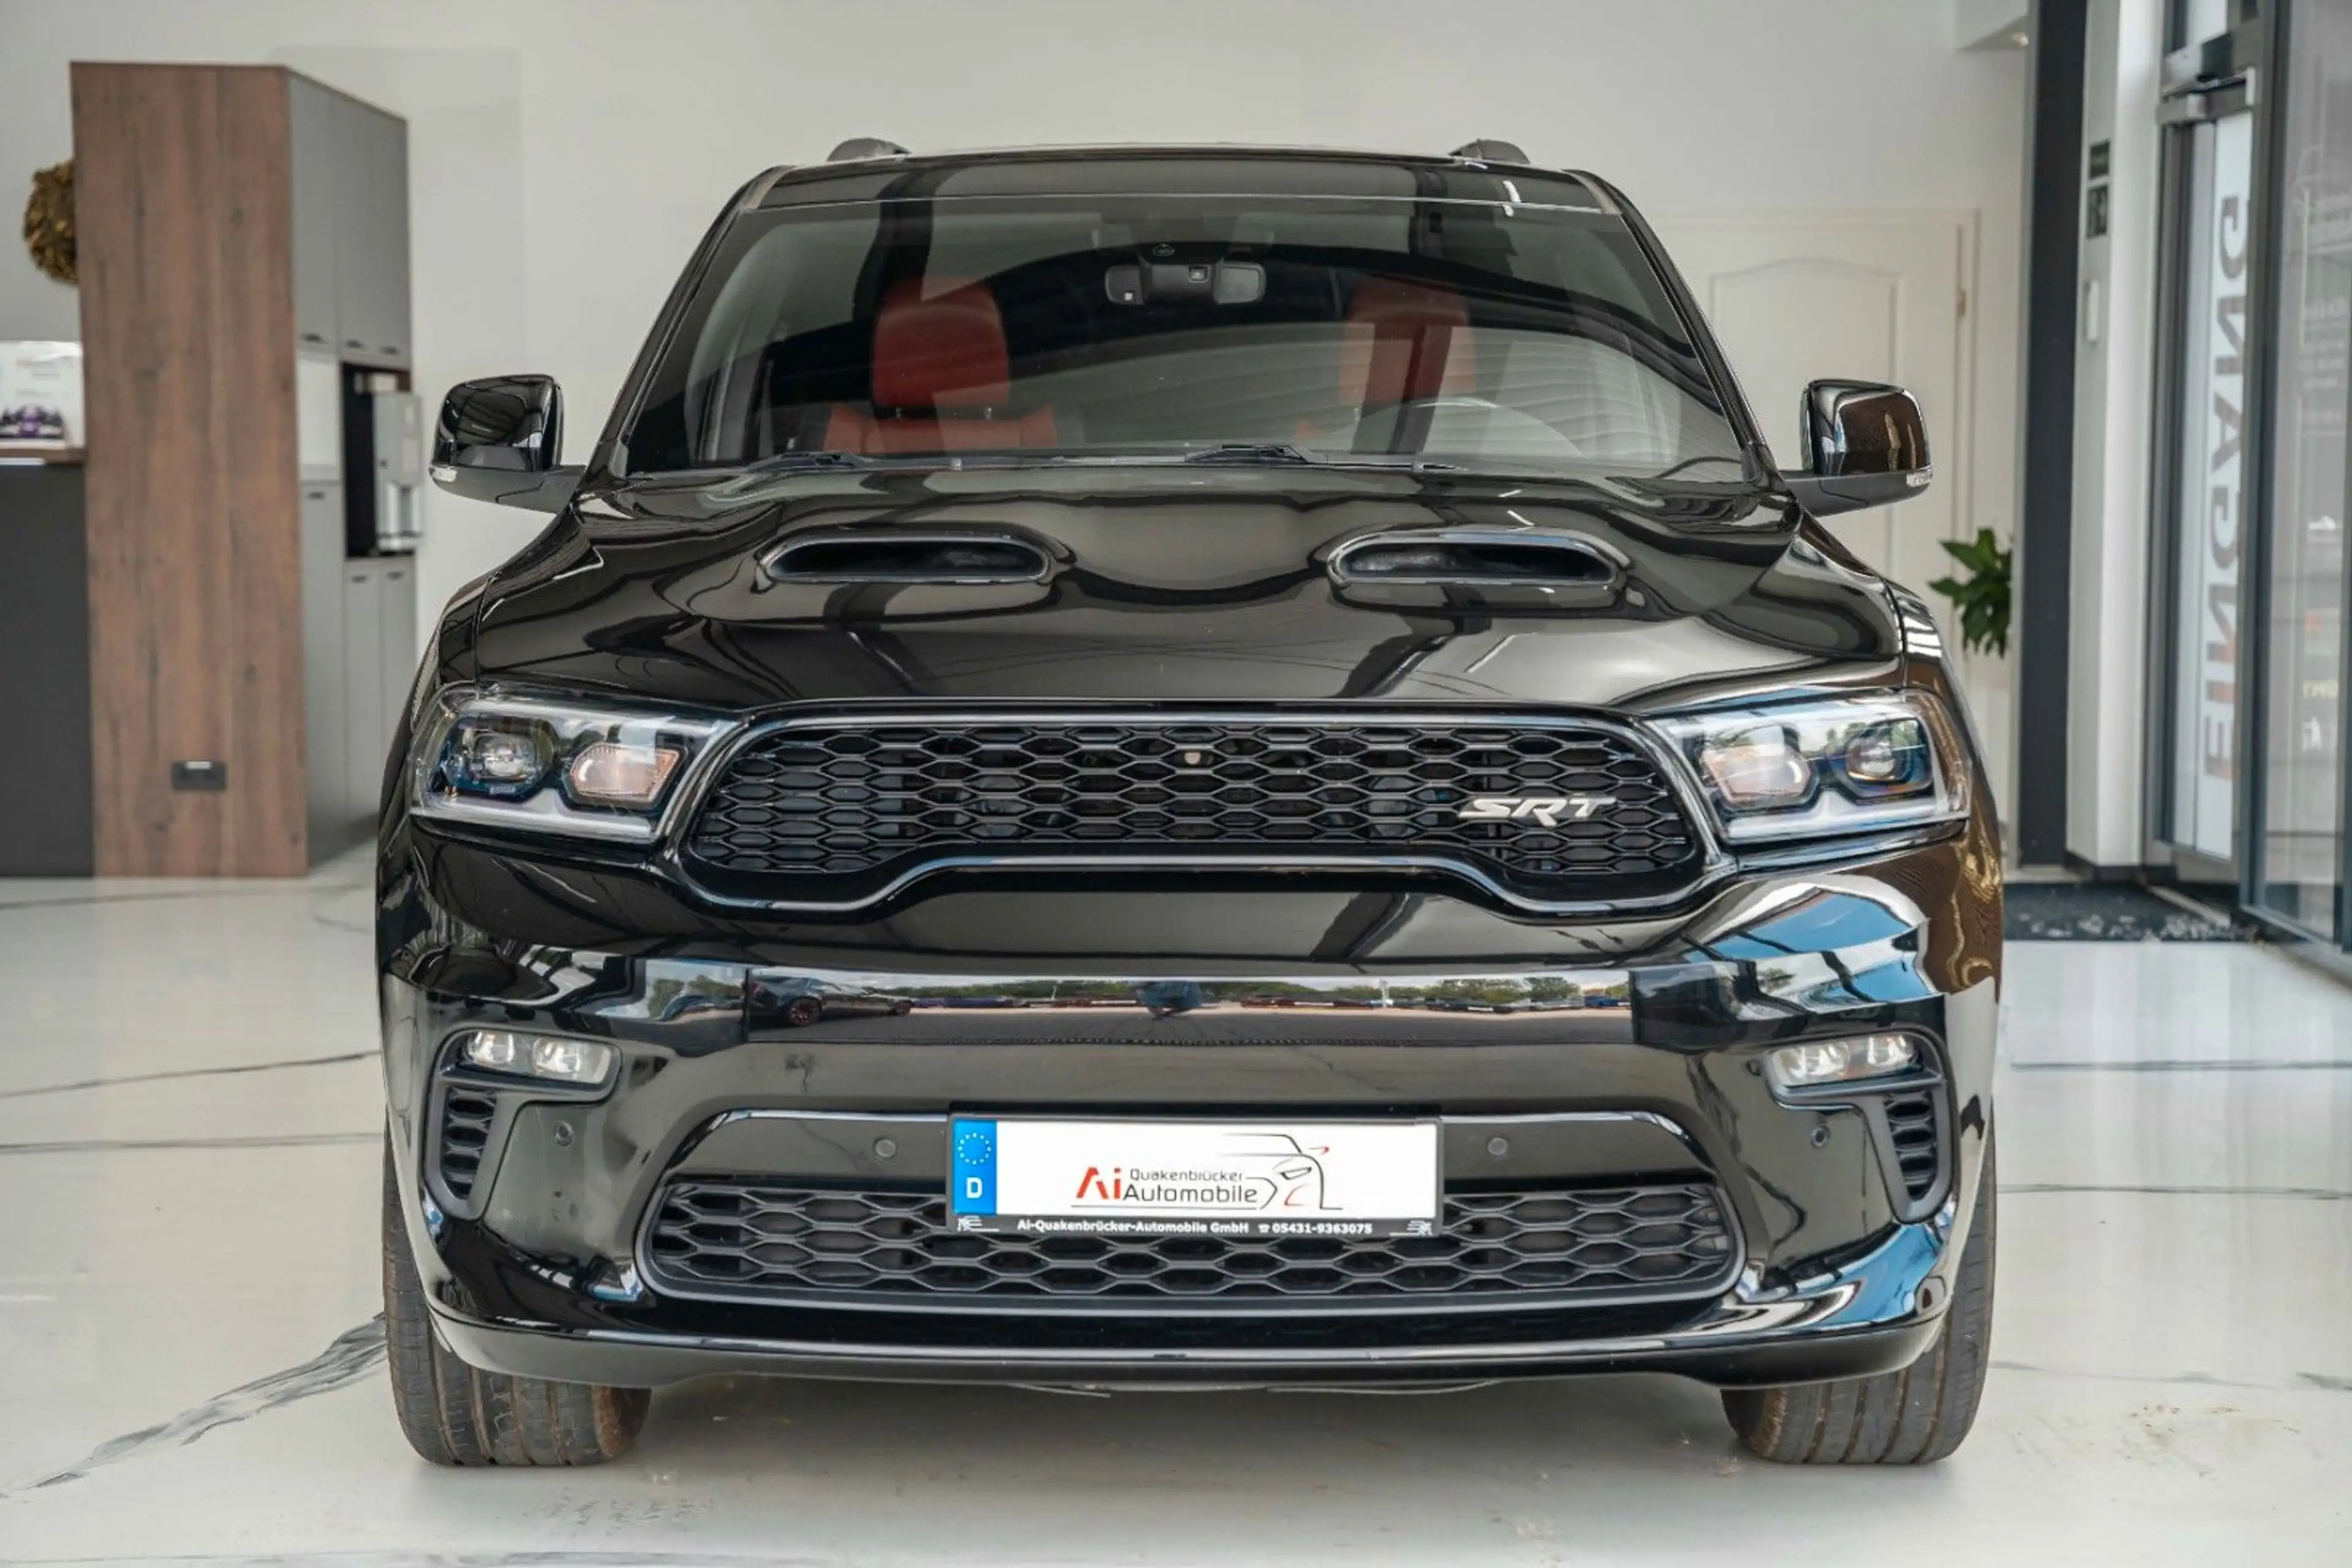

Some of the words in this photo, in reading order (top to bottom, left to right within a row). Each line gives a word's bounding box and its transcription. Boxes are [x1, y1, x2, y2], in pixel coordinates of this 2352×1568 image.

[1458, 797, 1616, 827] SRT
[1129, 1168, 1243, 1182] Quakenbrücker
[967, 1177, 982, 1199] D
[1123, 1183, 1257, 1203] Automobile
[1210, 1221, 1250, 1234] GmbH
